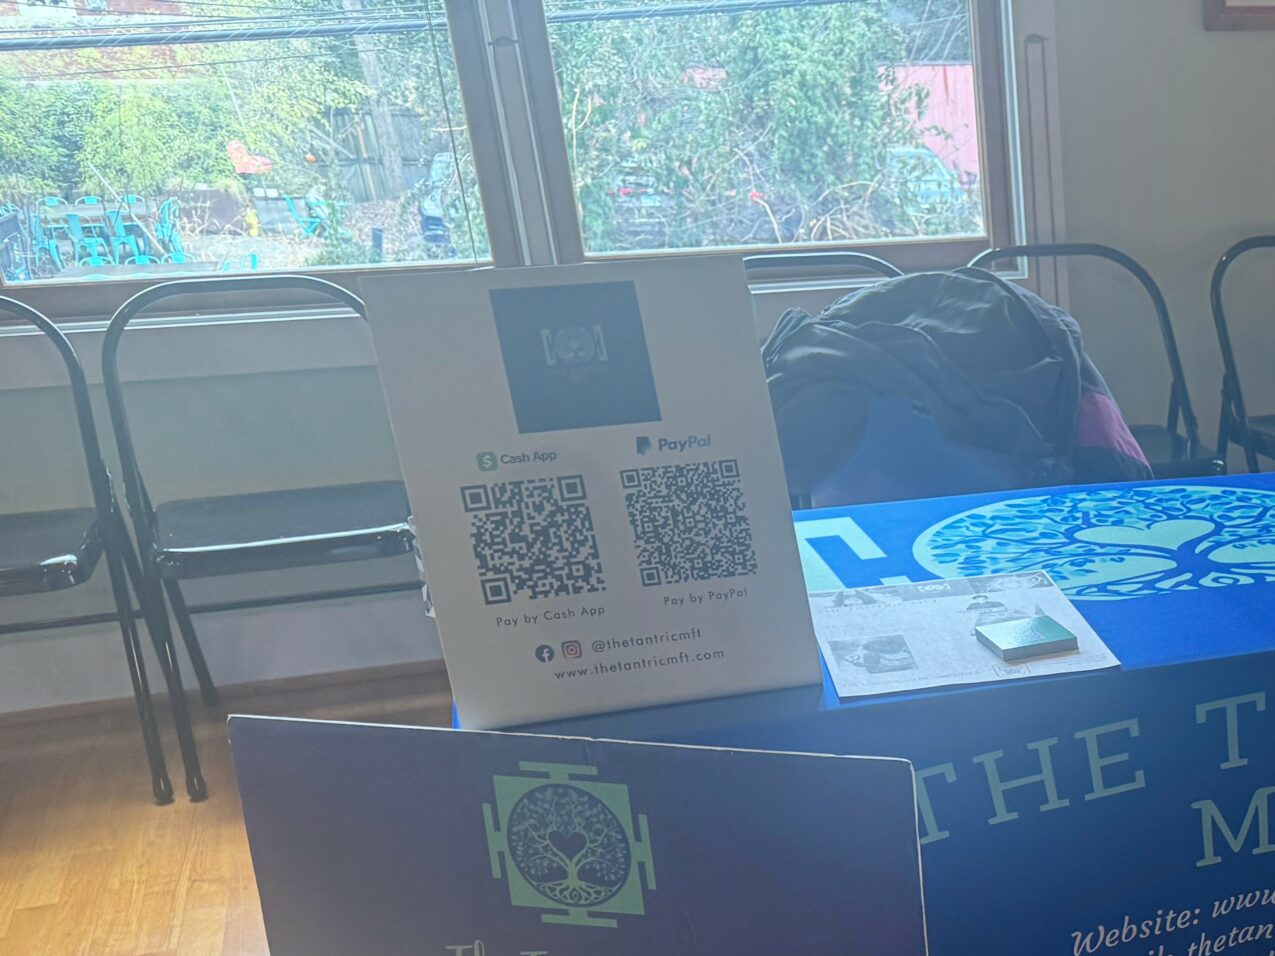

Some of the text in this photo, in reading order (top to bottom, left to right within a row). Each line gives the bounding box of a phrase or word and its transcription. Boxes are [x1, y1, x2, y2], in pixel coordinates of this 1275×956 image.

[658, 434, 711, 452] PayPal
[500, 450, 557, 465] Cash App
[664, 588, 748, 607] Pay by PayPal
[496, 605, 605, 627] Pay by Cash App
[592, 627, 702, 653] @thetantricmft
[554, 649, 725, 680] www.thetantricmft.com
[914, 718, 1146, 845] THE
[1071, 907, 1201, 956] Website:
